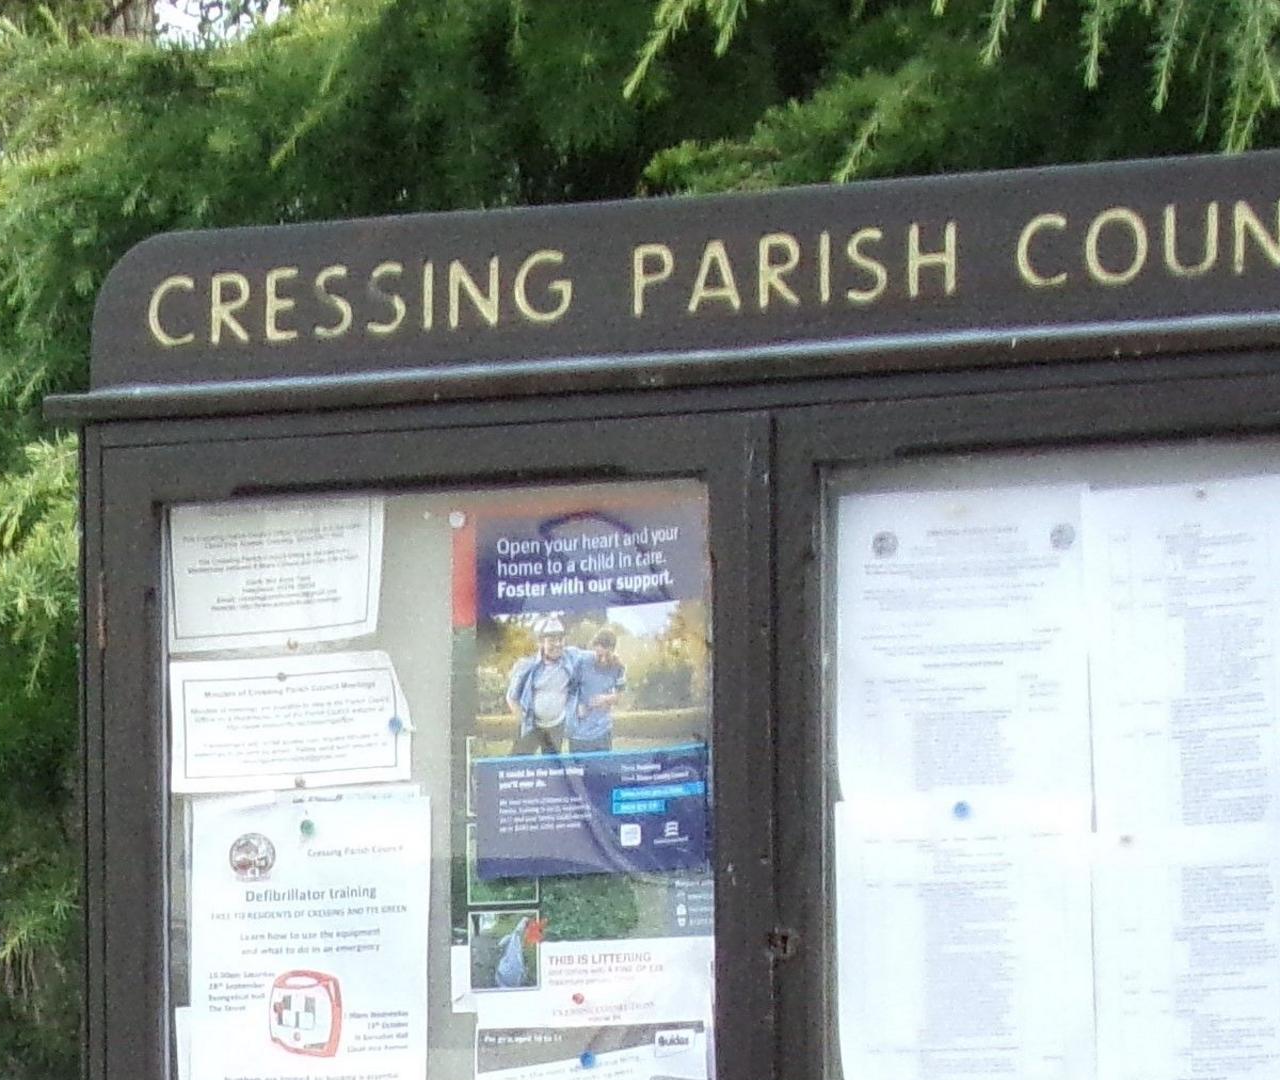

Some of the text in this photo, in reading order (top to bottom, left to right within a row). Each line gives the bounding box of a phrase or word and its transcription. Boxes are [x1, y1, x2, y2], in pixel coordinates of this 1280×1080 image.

[148, 248, 574, 346] CRESSING
[632, 219, 957, 318] PARISH
[497, 526, 679, 558] Open your heart and your
[498, 550, 667, 576] home to a child in care.
[498, 569, 674, 598] Foster with our support.
[307, 848, 342, 857] Cressing
[344, 847, 369, 855] Parish
[245, 885, 376, 902] Defibrillator training
[247, 910, 291, 919] RESIDENTS
[294, 910, 305, 918] OF
[381, 905, 407, 913] GREEN
[268, 931, 287, 940] how
[290, 931, 299, 940] to
[302, 932, 317, 940] use
[320, 931, 333, 939] the
[336, 927, 380, 940] equipment
[241, 947, 258, 955] and
[261, 945, 284, 954] what
[286, 946, 295, 954] to
[336, 943, 380, 954] emergency
[548, 952, 652, 966] THIS IS LITTERING
